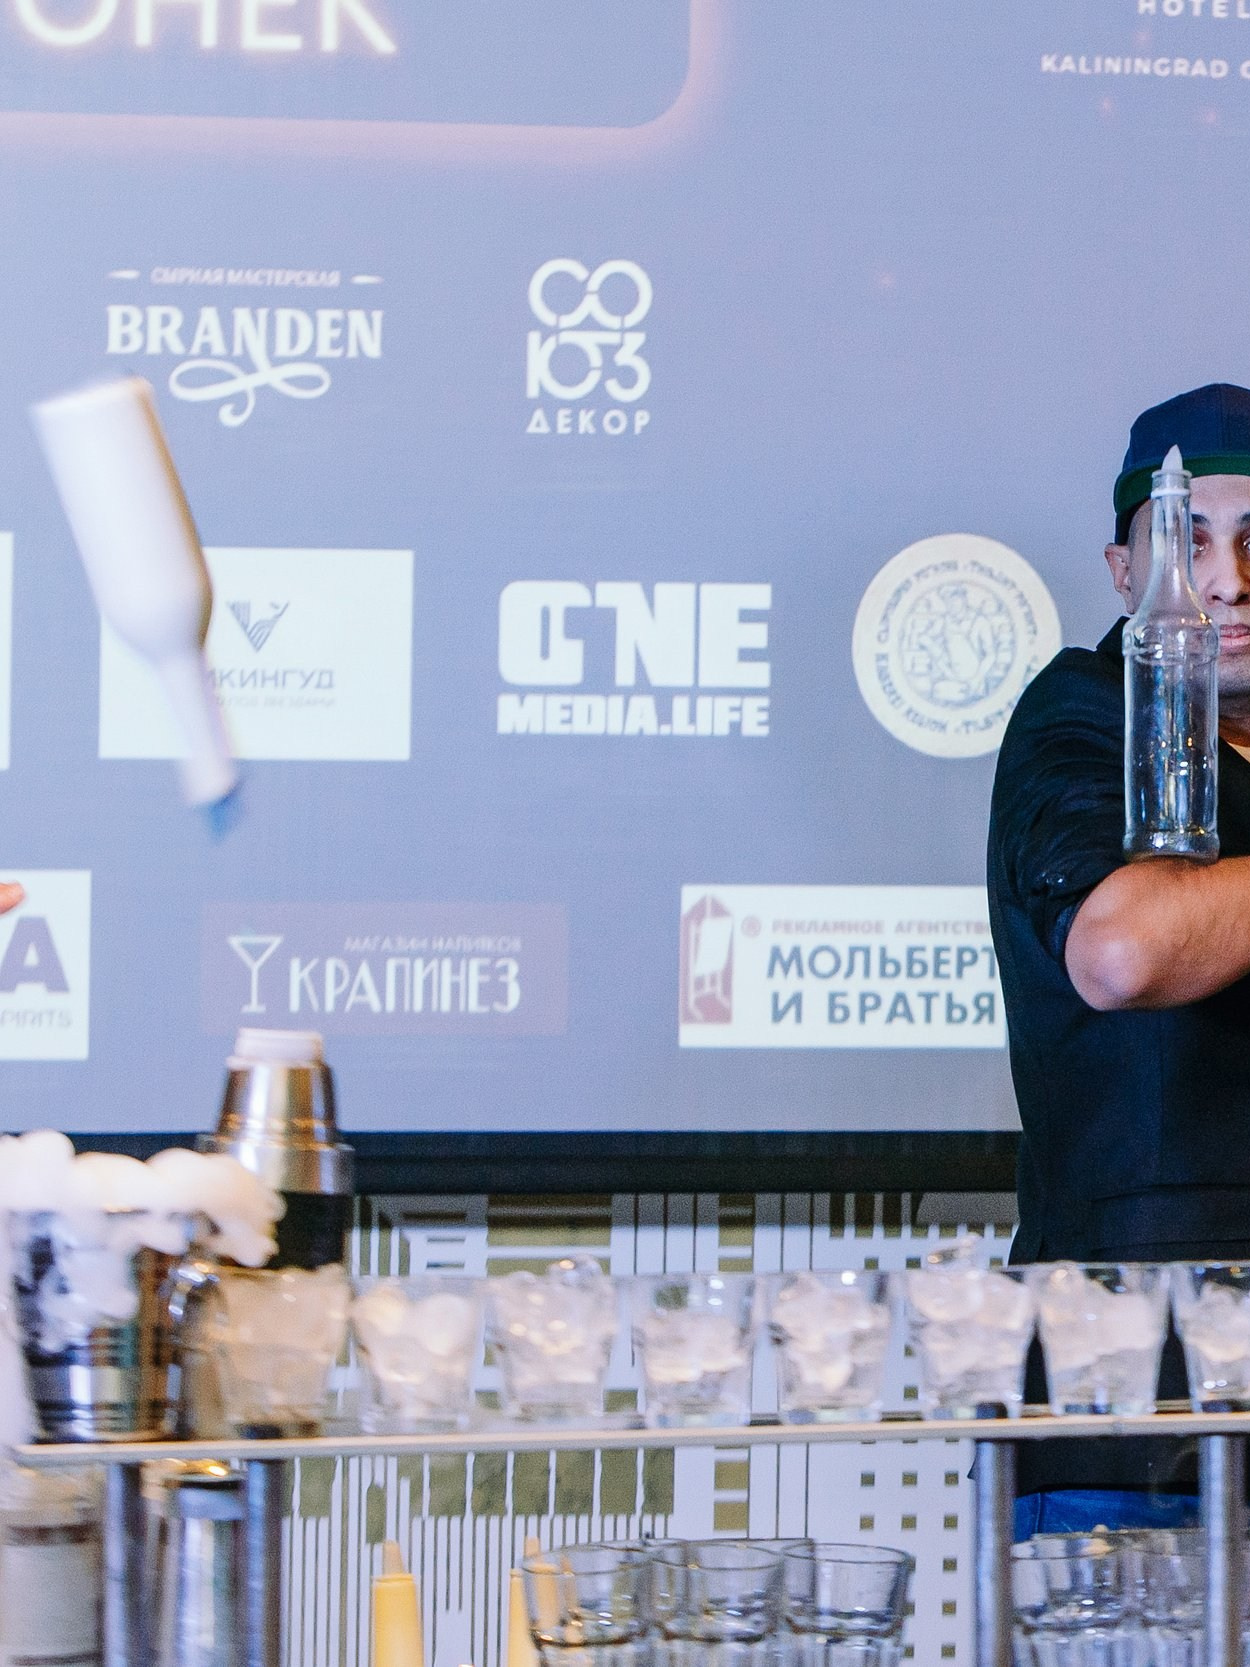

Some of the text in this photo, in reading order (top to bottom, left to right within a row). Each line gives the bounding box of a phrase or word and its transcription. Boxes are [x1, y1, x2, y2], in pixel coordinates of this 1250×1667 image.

[1040, 54, 1229, 80] KALININGRAD
[105, 304, 384, 359] BRANDEN
[525, 407, 651, 436] ДЕКОР
[499, 580, 772, 688] ONE
[497, 693, 770, 737] MEDIA.LIFE
[771, 919, 885, 935] РЕКЛАМНОЕ
[767, 944, 997, 980] МОЛЬБЕРТ
[288, 956, 522, 1014] КРАПИНЕЗ
[771, 990, 996, 1026] И БРАТЬЯ
